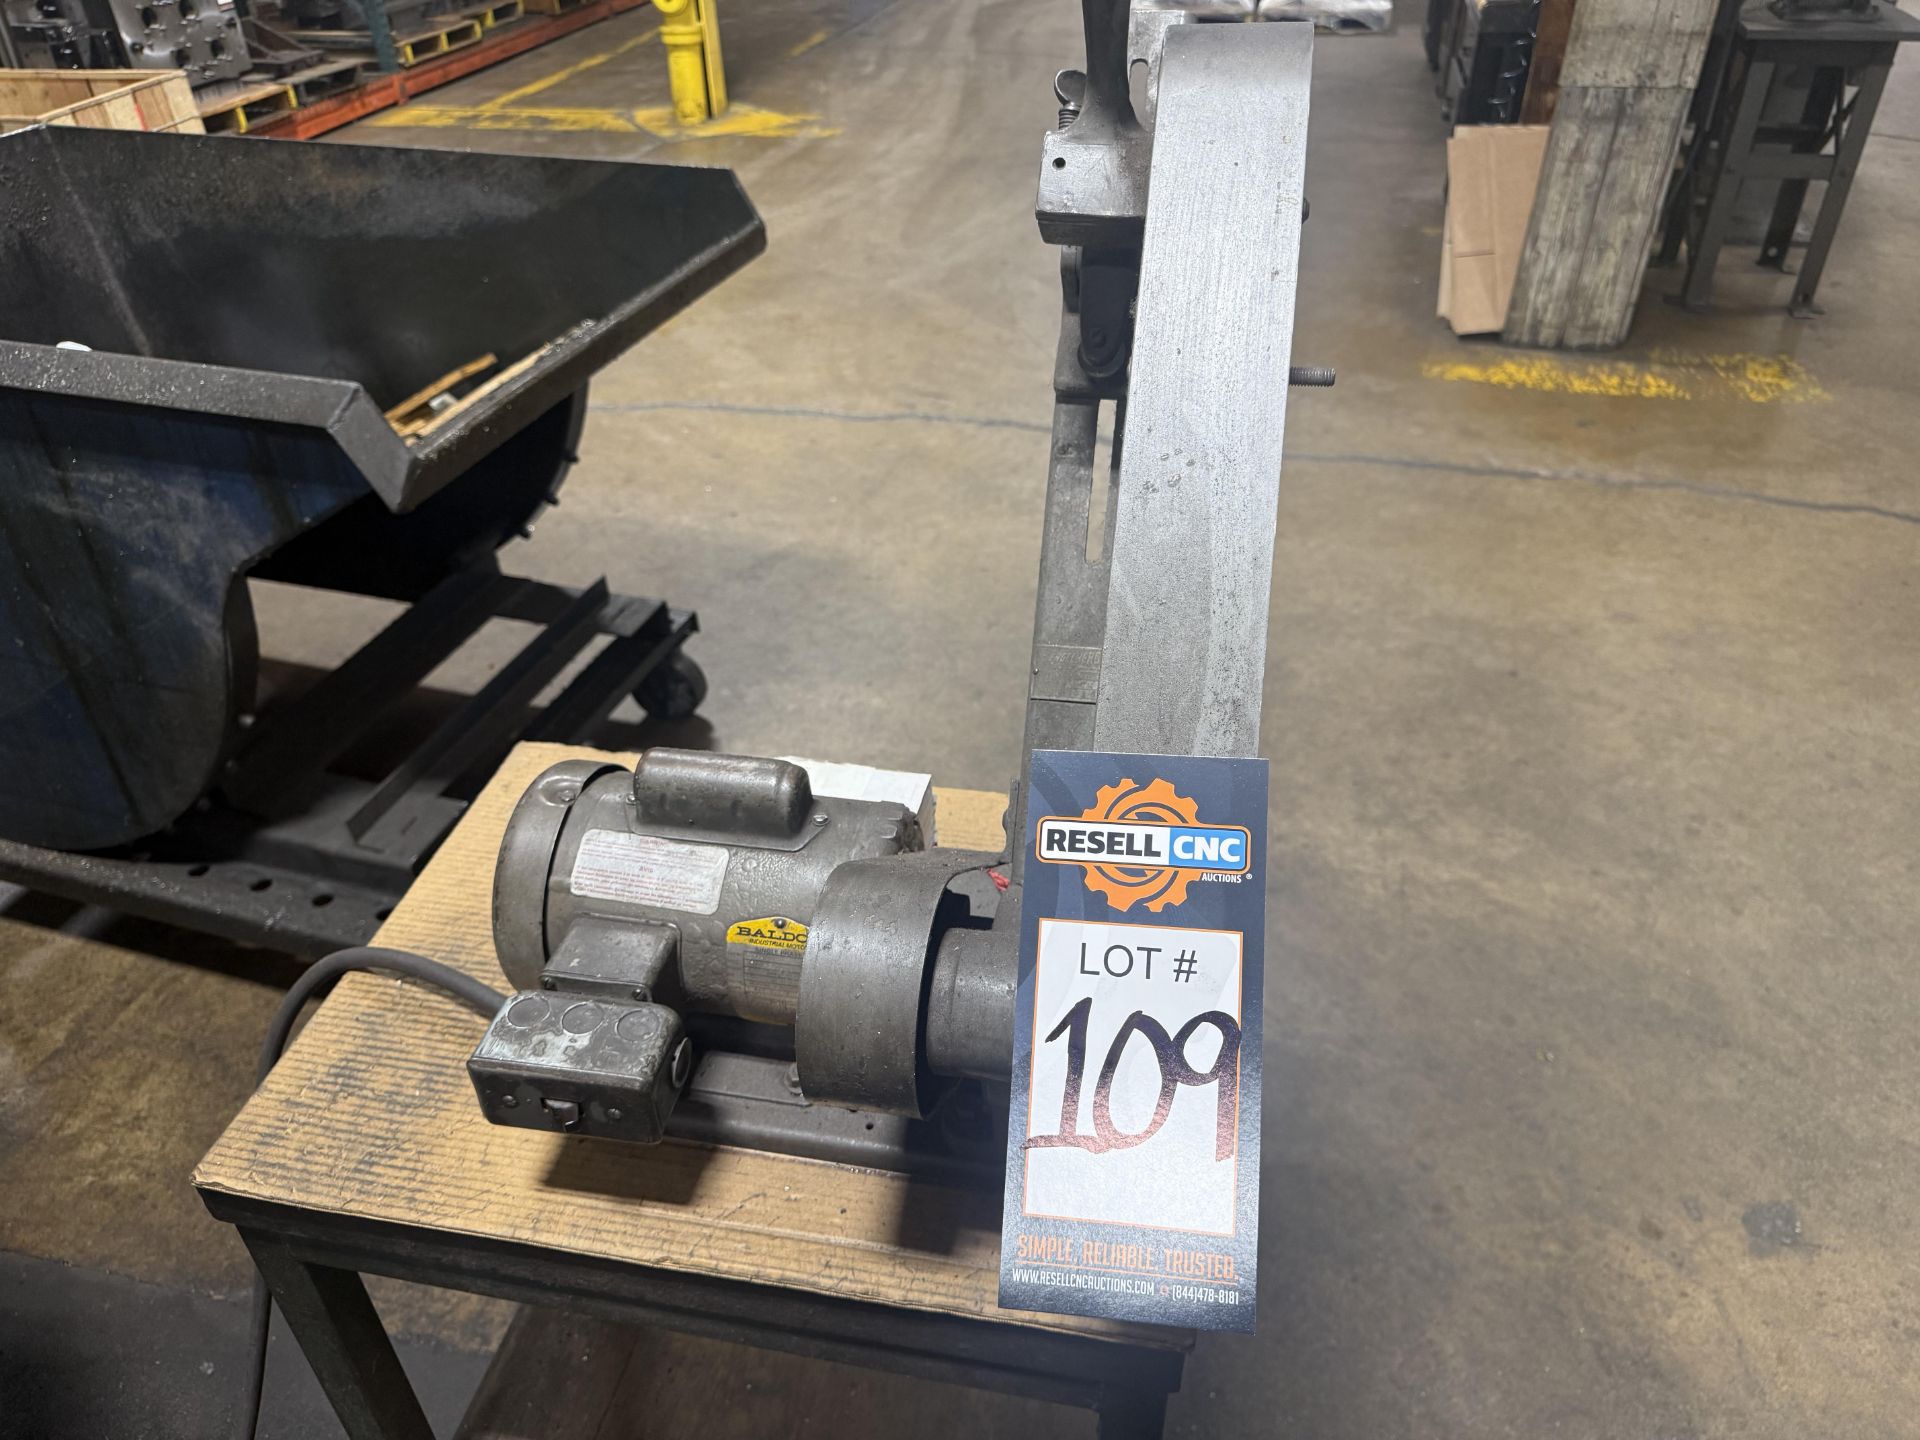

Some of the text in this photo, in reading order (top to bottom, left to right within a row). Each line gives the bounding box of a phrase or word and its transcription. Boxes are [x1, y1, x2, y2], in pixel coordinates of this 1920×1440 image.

[1046, 828, 1241, 862] RESELL CNC
[1202, 873, 1242, 883] AUCTIONS
[1080, 942, 1198, 983] LOT #
[1020, 996, 1242, 1163] 109
[1082, 1240, 1159, 1271] RELIABLE.
[1164, 1248, 1239, 1281] TRUSTED.
[1012, 1268, 1239, 1305] WWW.RESELLCNCAUCTIONS.COM (844)478-8181
